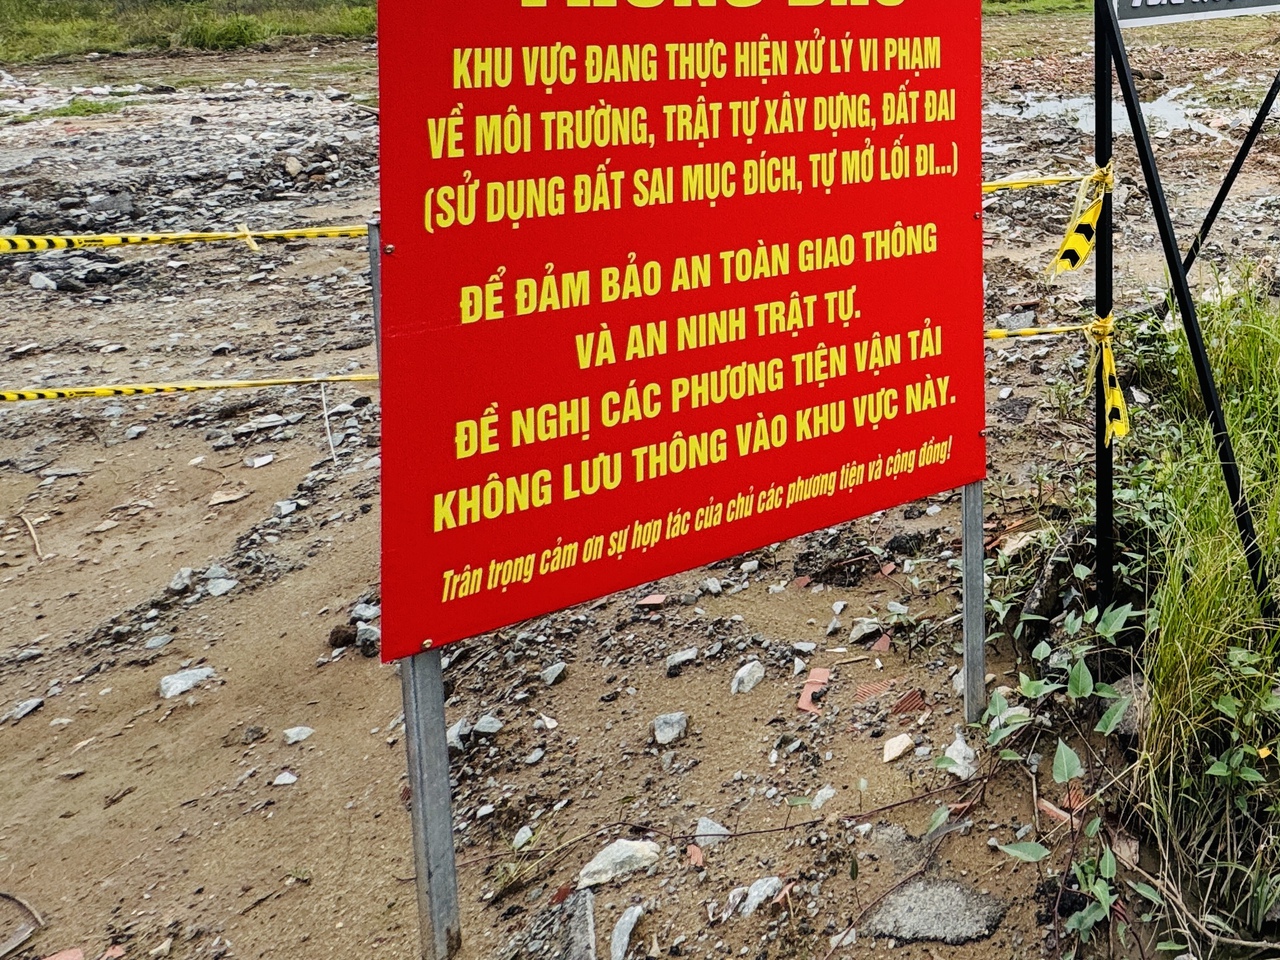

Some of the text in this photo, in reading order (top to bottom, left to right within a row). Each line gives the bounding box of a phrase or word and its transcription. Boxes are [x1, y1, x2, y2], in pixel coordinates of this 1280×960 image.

[453, 27, 941, 95] KHU VỰC ĐANG THỰC HIỆN XỬ LÝ VI PHẠM
[427, 79, 956, 160] VỀ MÔI TRƯỜNG, TRẬT TỰ XÂY DỰNG, ĐẤT ĐAI
[424, 133, 959, 234] (SỬ DỤNG ĐẤT SAI MỤC ĐÍCH, TỰ MỞ LỐI ĐI...)
[459, 220, 937, 325] ĐỂ ĐẢM BẢO AN TOÀN GIAO THÔNG
[575, 284, 861, 370] VÀ AN NINH TRẬT TỰ.
[454, 317, 942, 460] ĐỀ NGHỊ CÁC PHƯƠNG TIỆN VẬN TẢI
[433, 373, 956, 533] KHÔNG LƯU THÔNG VÀO KHU VỰC NÀY.
[441, 435, 953, 603] Trân trọng cảm ơn sự hợp tác của chủ các phương tiện và cộng đồng!
